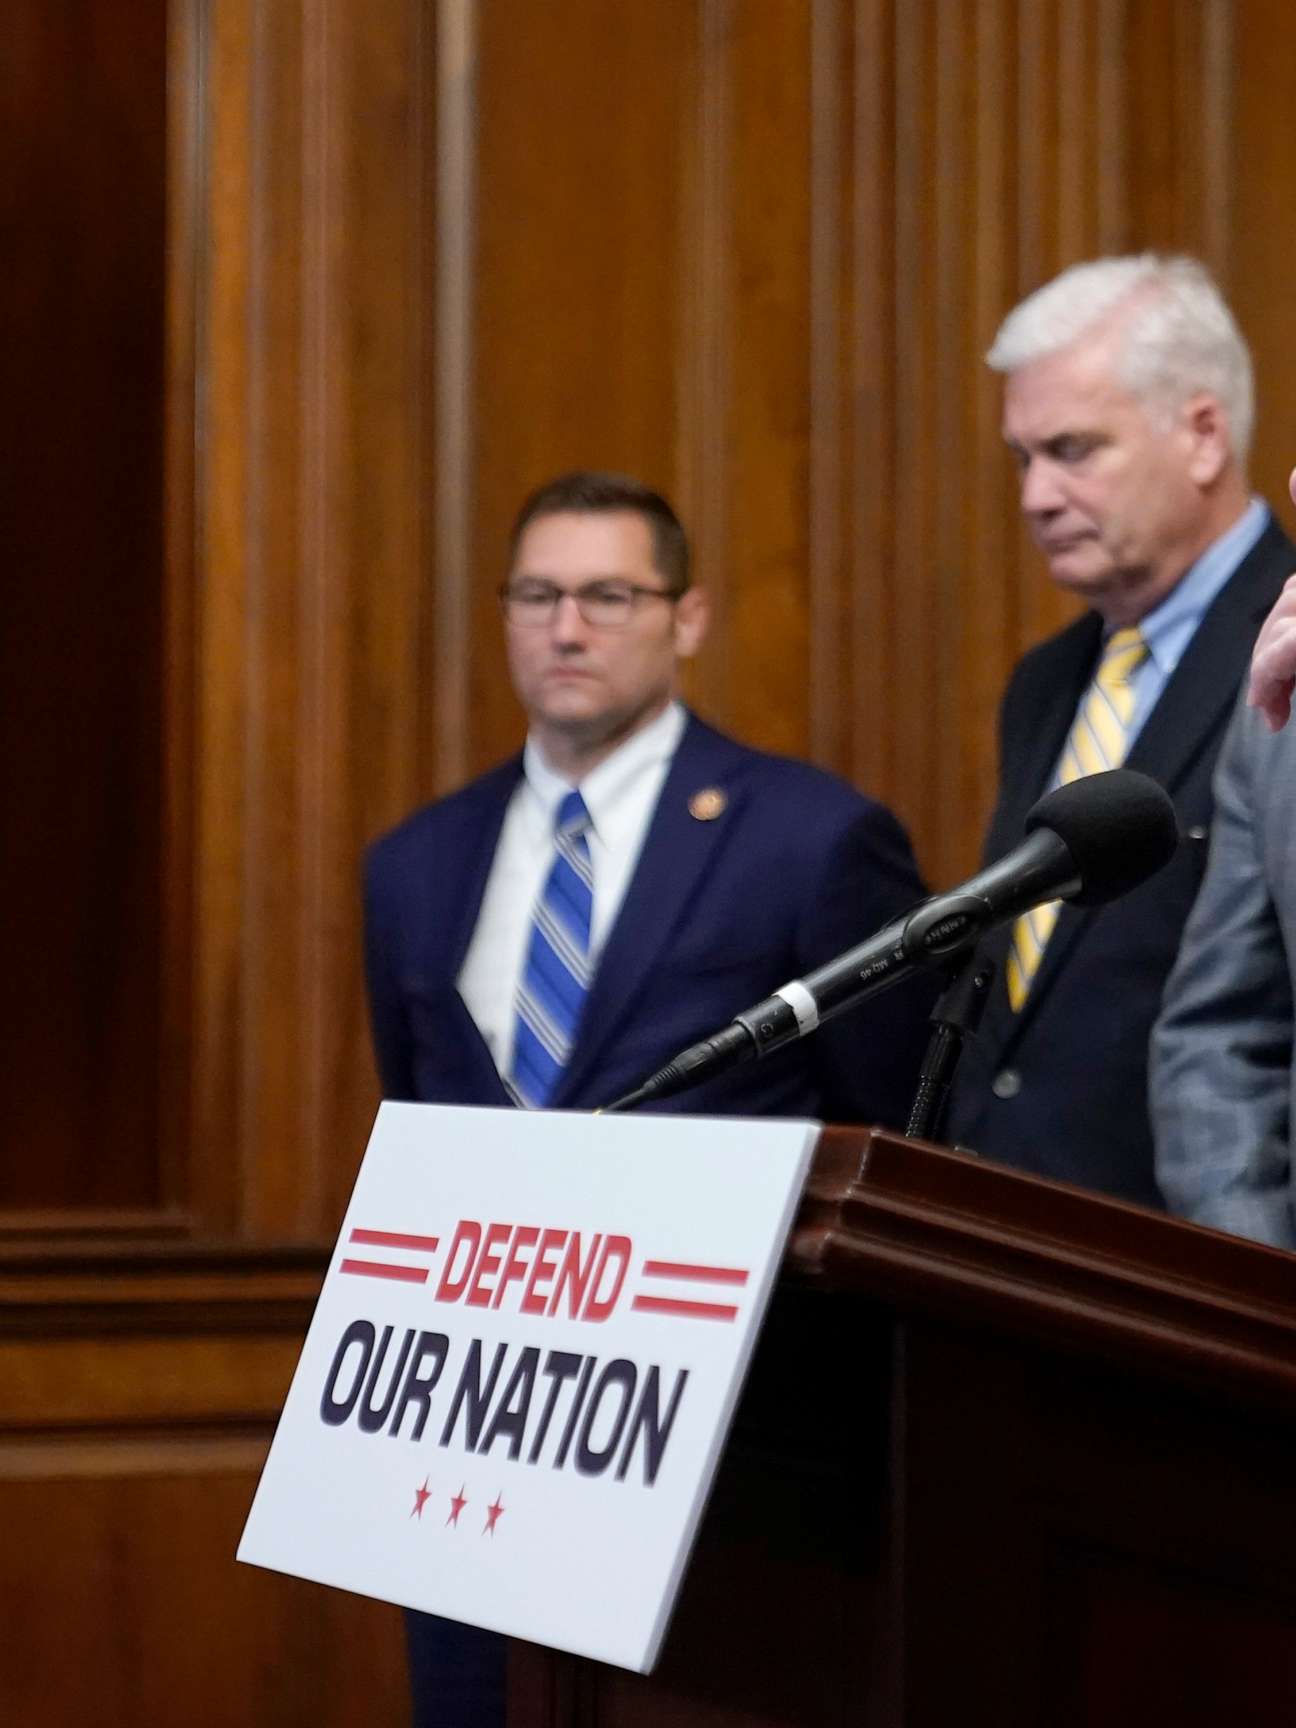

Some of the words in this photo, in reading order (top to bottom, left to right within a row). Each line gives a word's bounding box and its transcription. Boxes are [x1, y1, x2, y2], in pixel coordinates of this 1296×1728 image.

[436, 1220, 632, 1322] DEFEND
[320, 1319, 449, 1442] OUR
[440, 1339, 690, 1486] NATION
